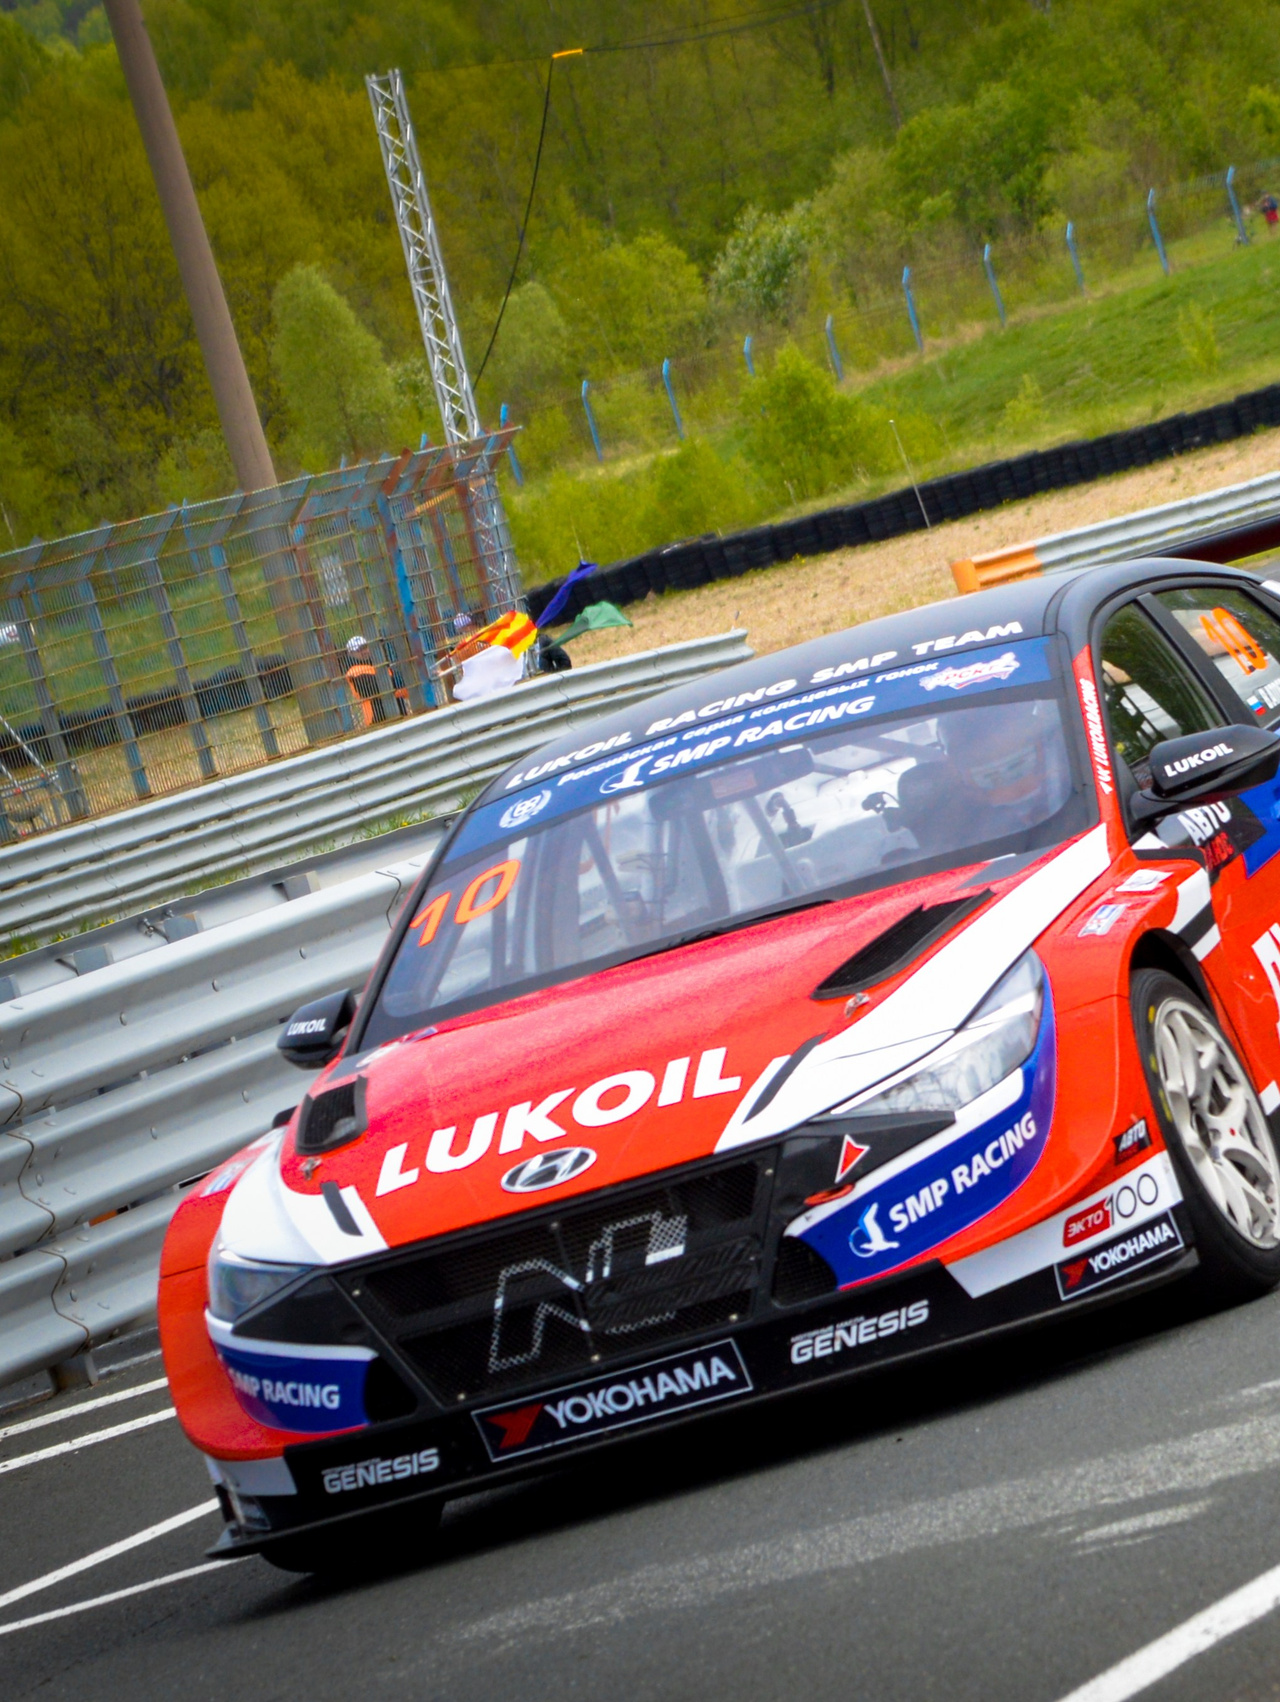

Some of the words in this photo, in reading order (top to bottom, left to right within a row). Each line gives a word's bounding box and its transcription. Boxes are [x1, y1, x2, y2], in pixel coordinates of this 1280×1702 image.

[1198, 606, 1269, 676] 10
[505, 731, 633, 790] LUKOIL
[646, 678, 797, 735] RACING
[810, 650, 898, 684] SMP
[912, 621, 1024, 656] TEAM
[556, 736, 678, 787] Российская
[681, 714, 746, 741] серия
[875, 662, 940, 684] гонок
[648, 735, 732, 776] SMP
[733, 695, 876, 748] RACING
[1163, 742, 1235, 778] LUKOIL
[409, 858, 522, 948] 10
[286, 1017, 327, 1036] LUKOIL
[375, 1046, 742, 1198] LUKOIL
[888, 1178, 949, 1234] SMP
[951, 1111, 1037, 1195] RACING
[1066, 1209, 1104, 1238] ЭКТО
[1105, 1172, 1159, 1226] 100
[1088, 1221, 1176, 1274] YOKOHAMA
[790, 1300, 930, 1365] GENESIS
[261, 1379, 341, 1410] RACING
[543, 1355, 737, 1429] YOKOHAMA
[322, 1448, 440, 1494] GENESIS
